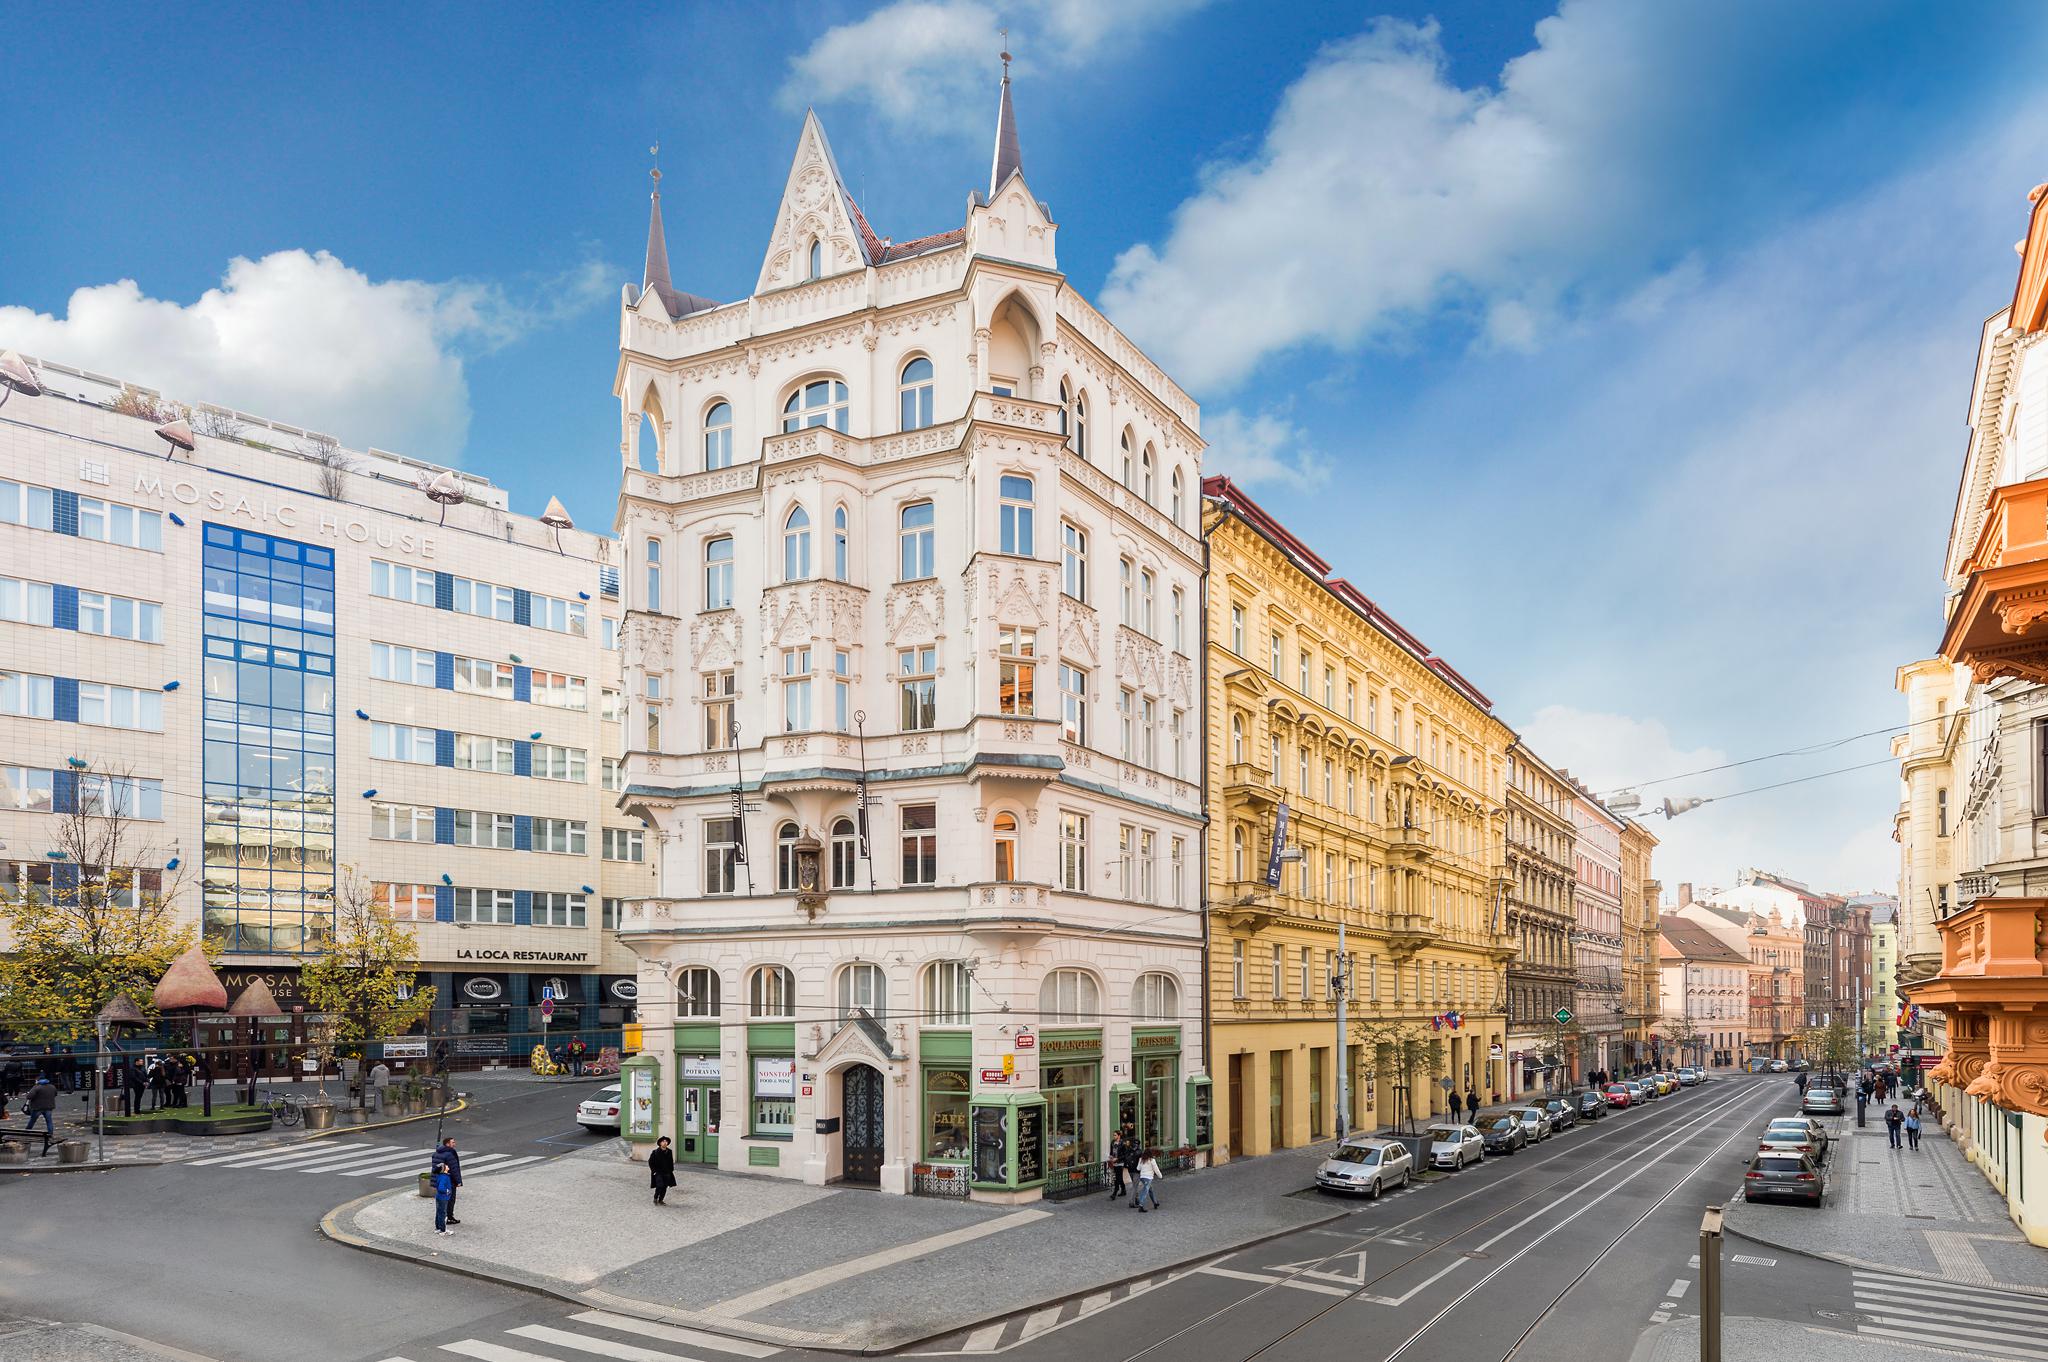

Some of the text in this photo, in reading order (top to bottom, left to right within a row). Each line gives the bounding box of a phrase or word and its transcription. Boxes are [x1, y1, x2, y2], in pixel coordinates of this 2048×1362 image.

[134, 472, 435, 560] MOSAIC HOUSE
[457, 949, 588, 962] LA LOCA RESTAURANT
[1041, 1039, 1102, 1052] BOULANGERIE
[934, 1112, 965, 1124] CAFÉ
